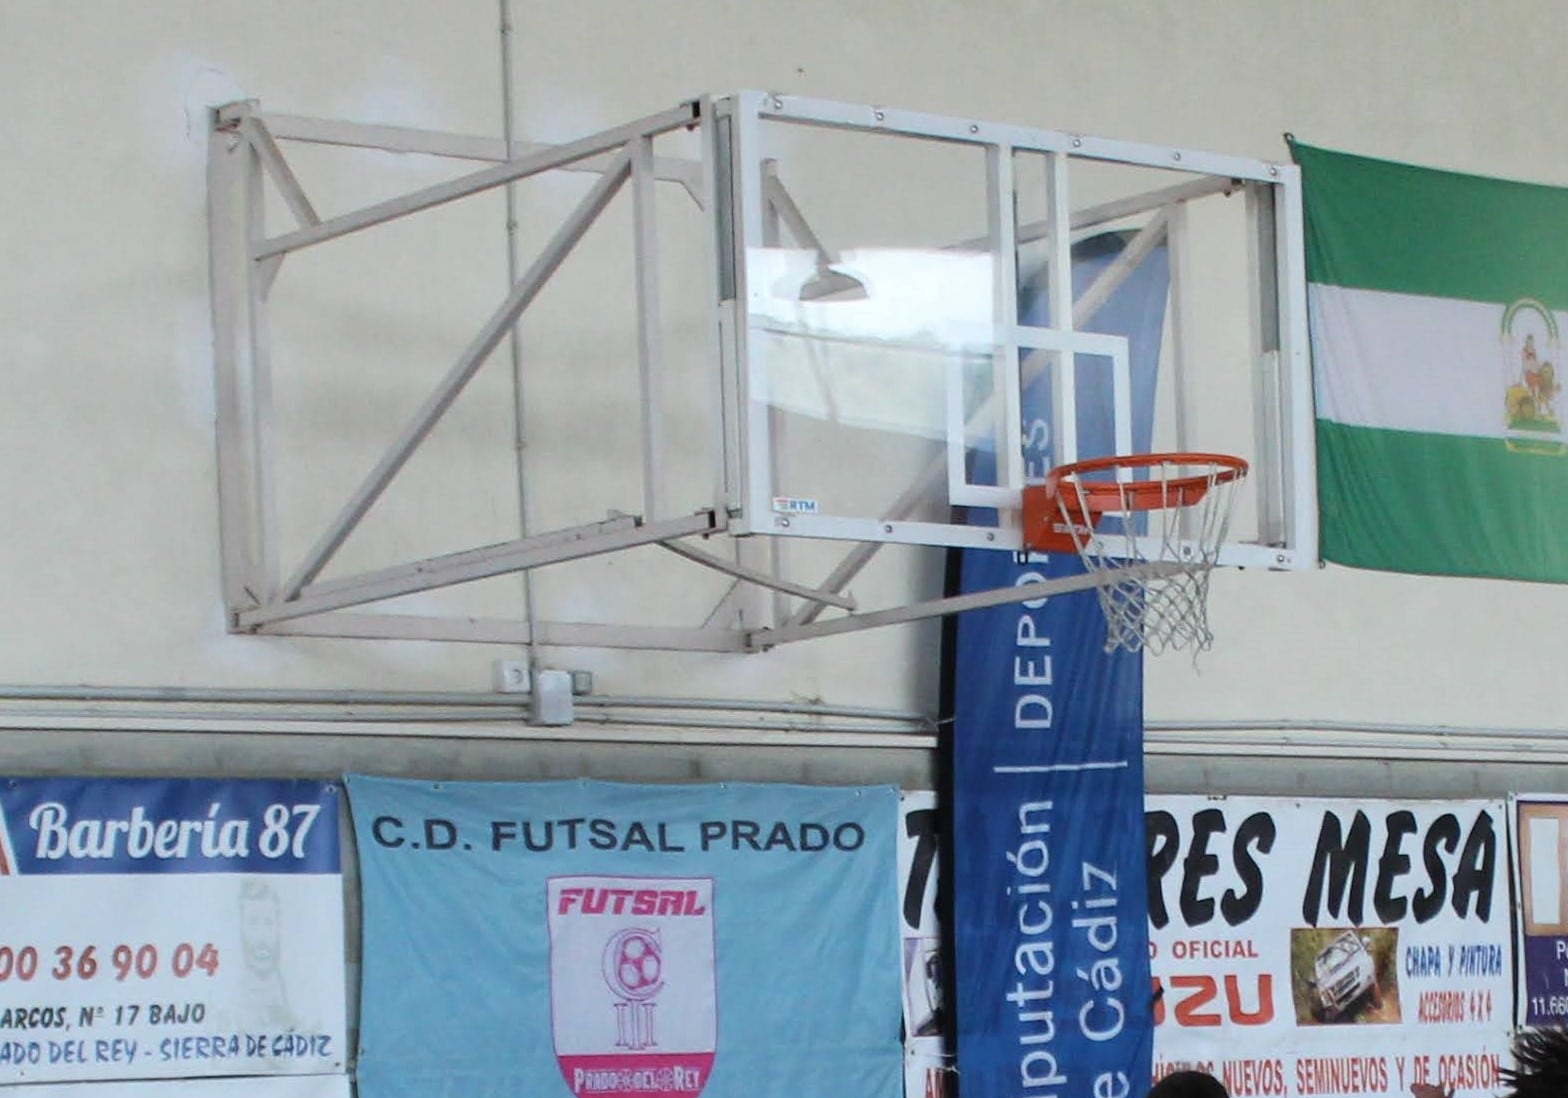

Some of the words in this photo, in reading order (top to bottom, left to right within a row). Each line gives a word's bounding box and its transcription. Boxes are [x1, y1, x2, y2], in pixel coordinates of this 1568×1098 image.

[29, 801, 250, 861] Barbería
[258, 802, 322, 861] 87
[371, 815, 472, 851] C.D.
[490, 817, 686, 853] FUTSAL
[699, 820, 867, 853] PRADO
[1302, 808, 1496, 926] MESA
[557, 887, 706, 916] FUTSAL
[52, 945, 98, 981] 36
[111, 943, 159, 982] 90
[172, 942, 220, 979] 04
[1072, 861, 1126, 1043] Cádiz
[1171, 939, 1260, 960] OFICIAL
[1405, 945, 1442, 978] CHAPA
[1448, 944, 1456, 974] Y
[1459, 944, 1503, 977] PINTURA
[115, 1004, 140, 1026] 17
[149, 1002, 206, 1025] BAJO
[48, 1038, 87, 1065] DEL
[96, 1038, 137, 1064] REY
[160, 1034, 239, 1059] SIERRA
[246, 1034, 268, 1058] DE
[271, 1030, 334, 1058] CÁDIZ
[1296, 1055, 1389, 1094] SEMINUEVOS
[1395, 1056, 1406, 1092] Y
[1438, 1047, 1500, 1091] OCASIÓN
